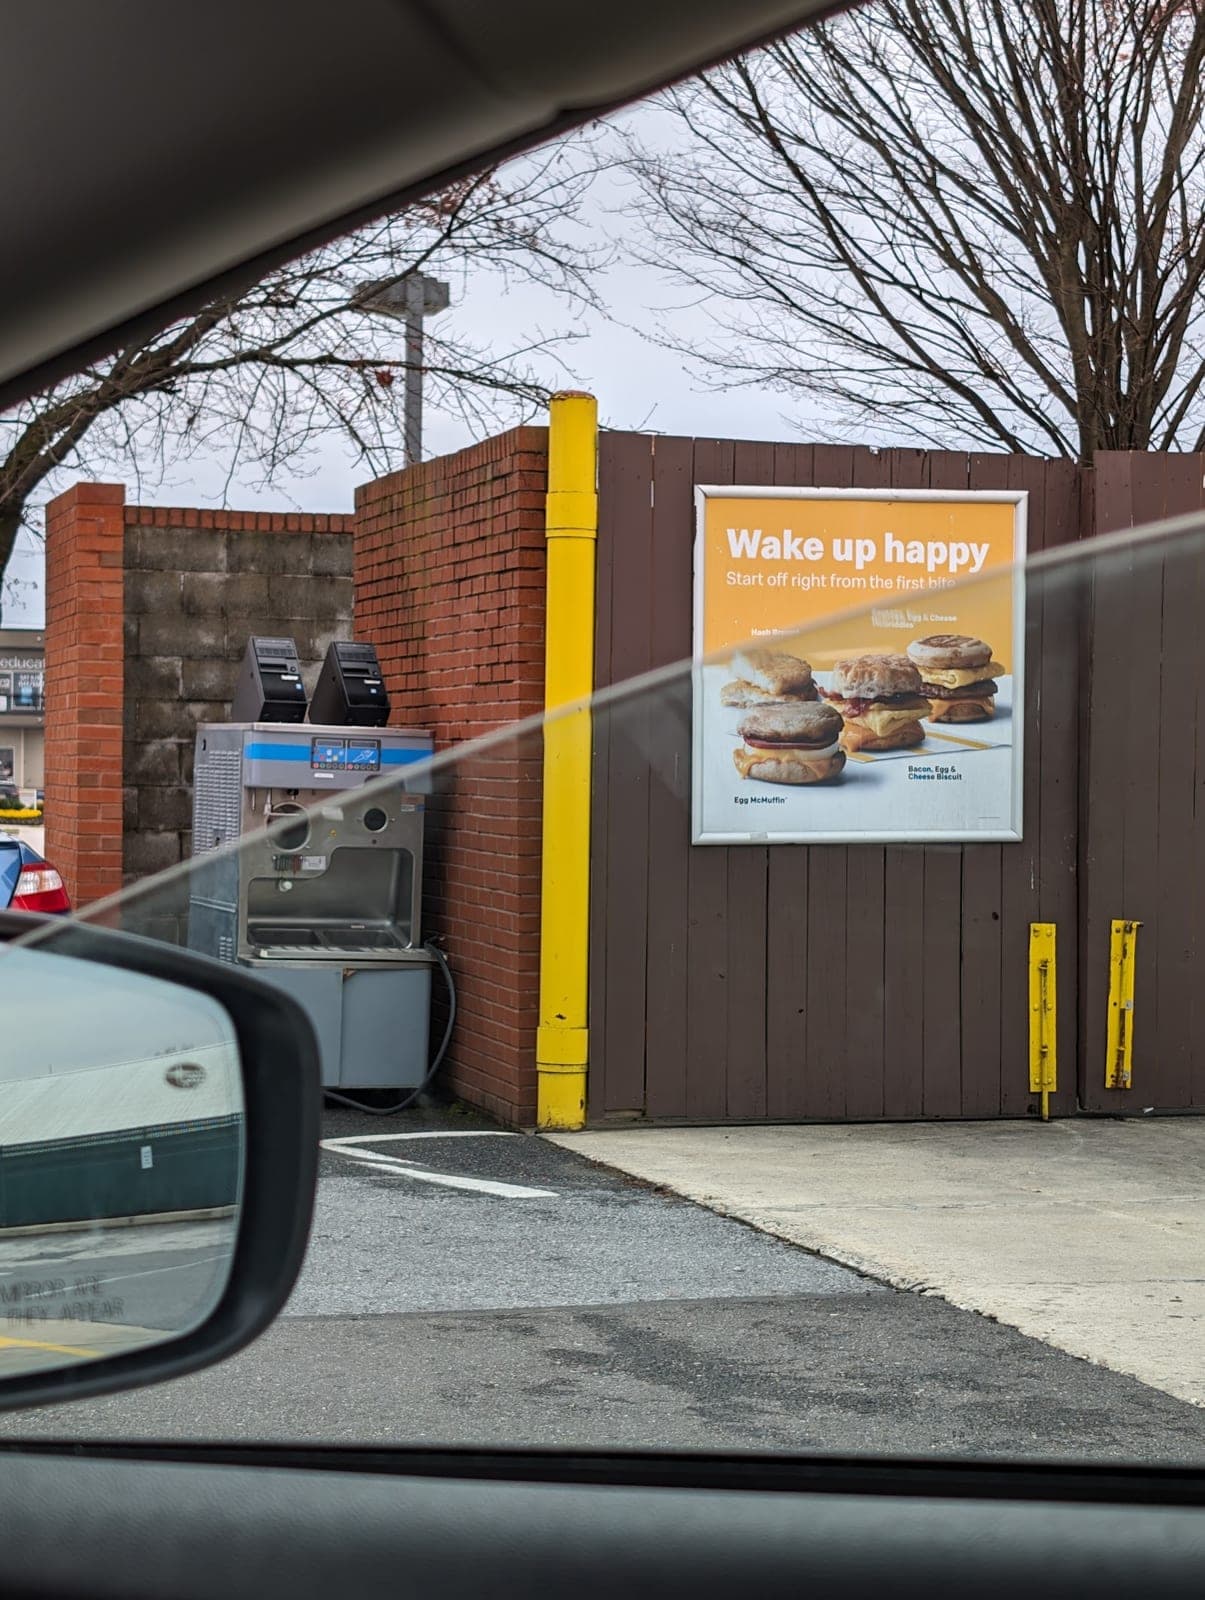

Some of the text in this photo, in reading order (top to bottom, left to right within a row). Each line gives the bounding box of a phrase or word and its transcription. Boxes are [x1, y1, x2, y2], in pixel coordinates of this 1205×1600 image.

[726, 528, 990, 573] Wake up happy
[726, 571, 764, 586] Start
[767, 572, 788, 587] off
[791, 573, 826, 591] right
[830, 573, 866, 588] from
[869, 575, 893, 589] the
[896, 576, 926, 590] first
[908, 765, 957, 774] Bacon, Egg &
[908, 773, 963, 781] Cheese Biscuit
[734, 796, 786, 805] Egg McMuffin
